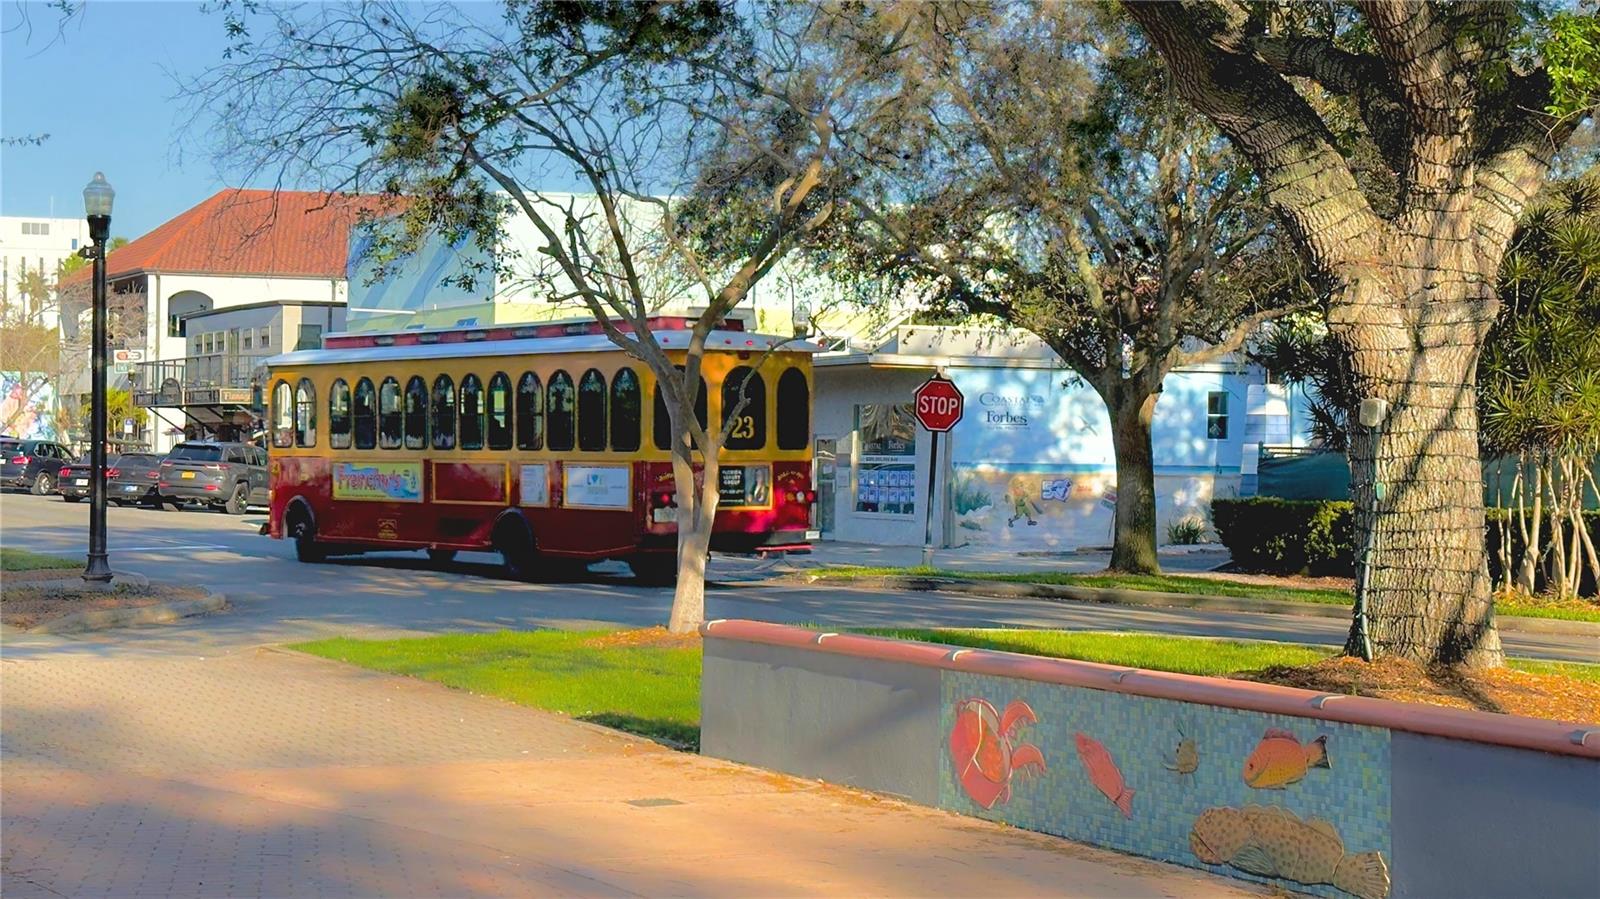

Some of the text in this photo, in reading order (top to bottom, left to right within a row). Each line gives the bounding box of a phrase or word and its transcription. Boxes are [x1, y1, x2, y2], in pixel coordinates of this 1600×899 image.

[920, 395, 958, 415] STOP
[987, 410, 1028, 423] Forbes
[731, 415, 755, 439] 23
